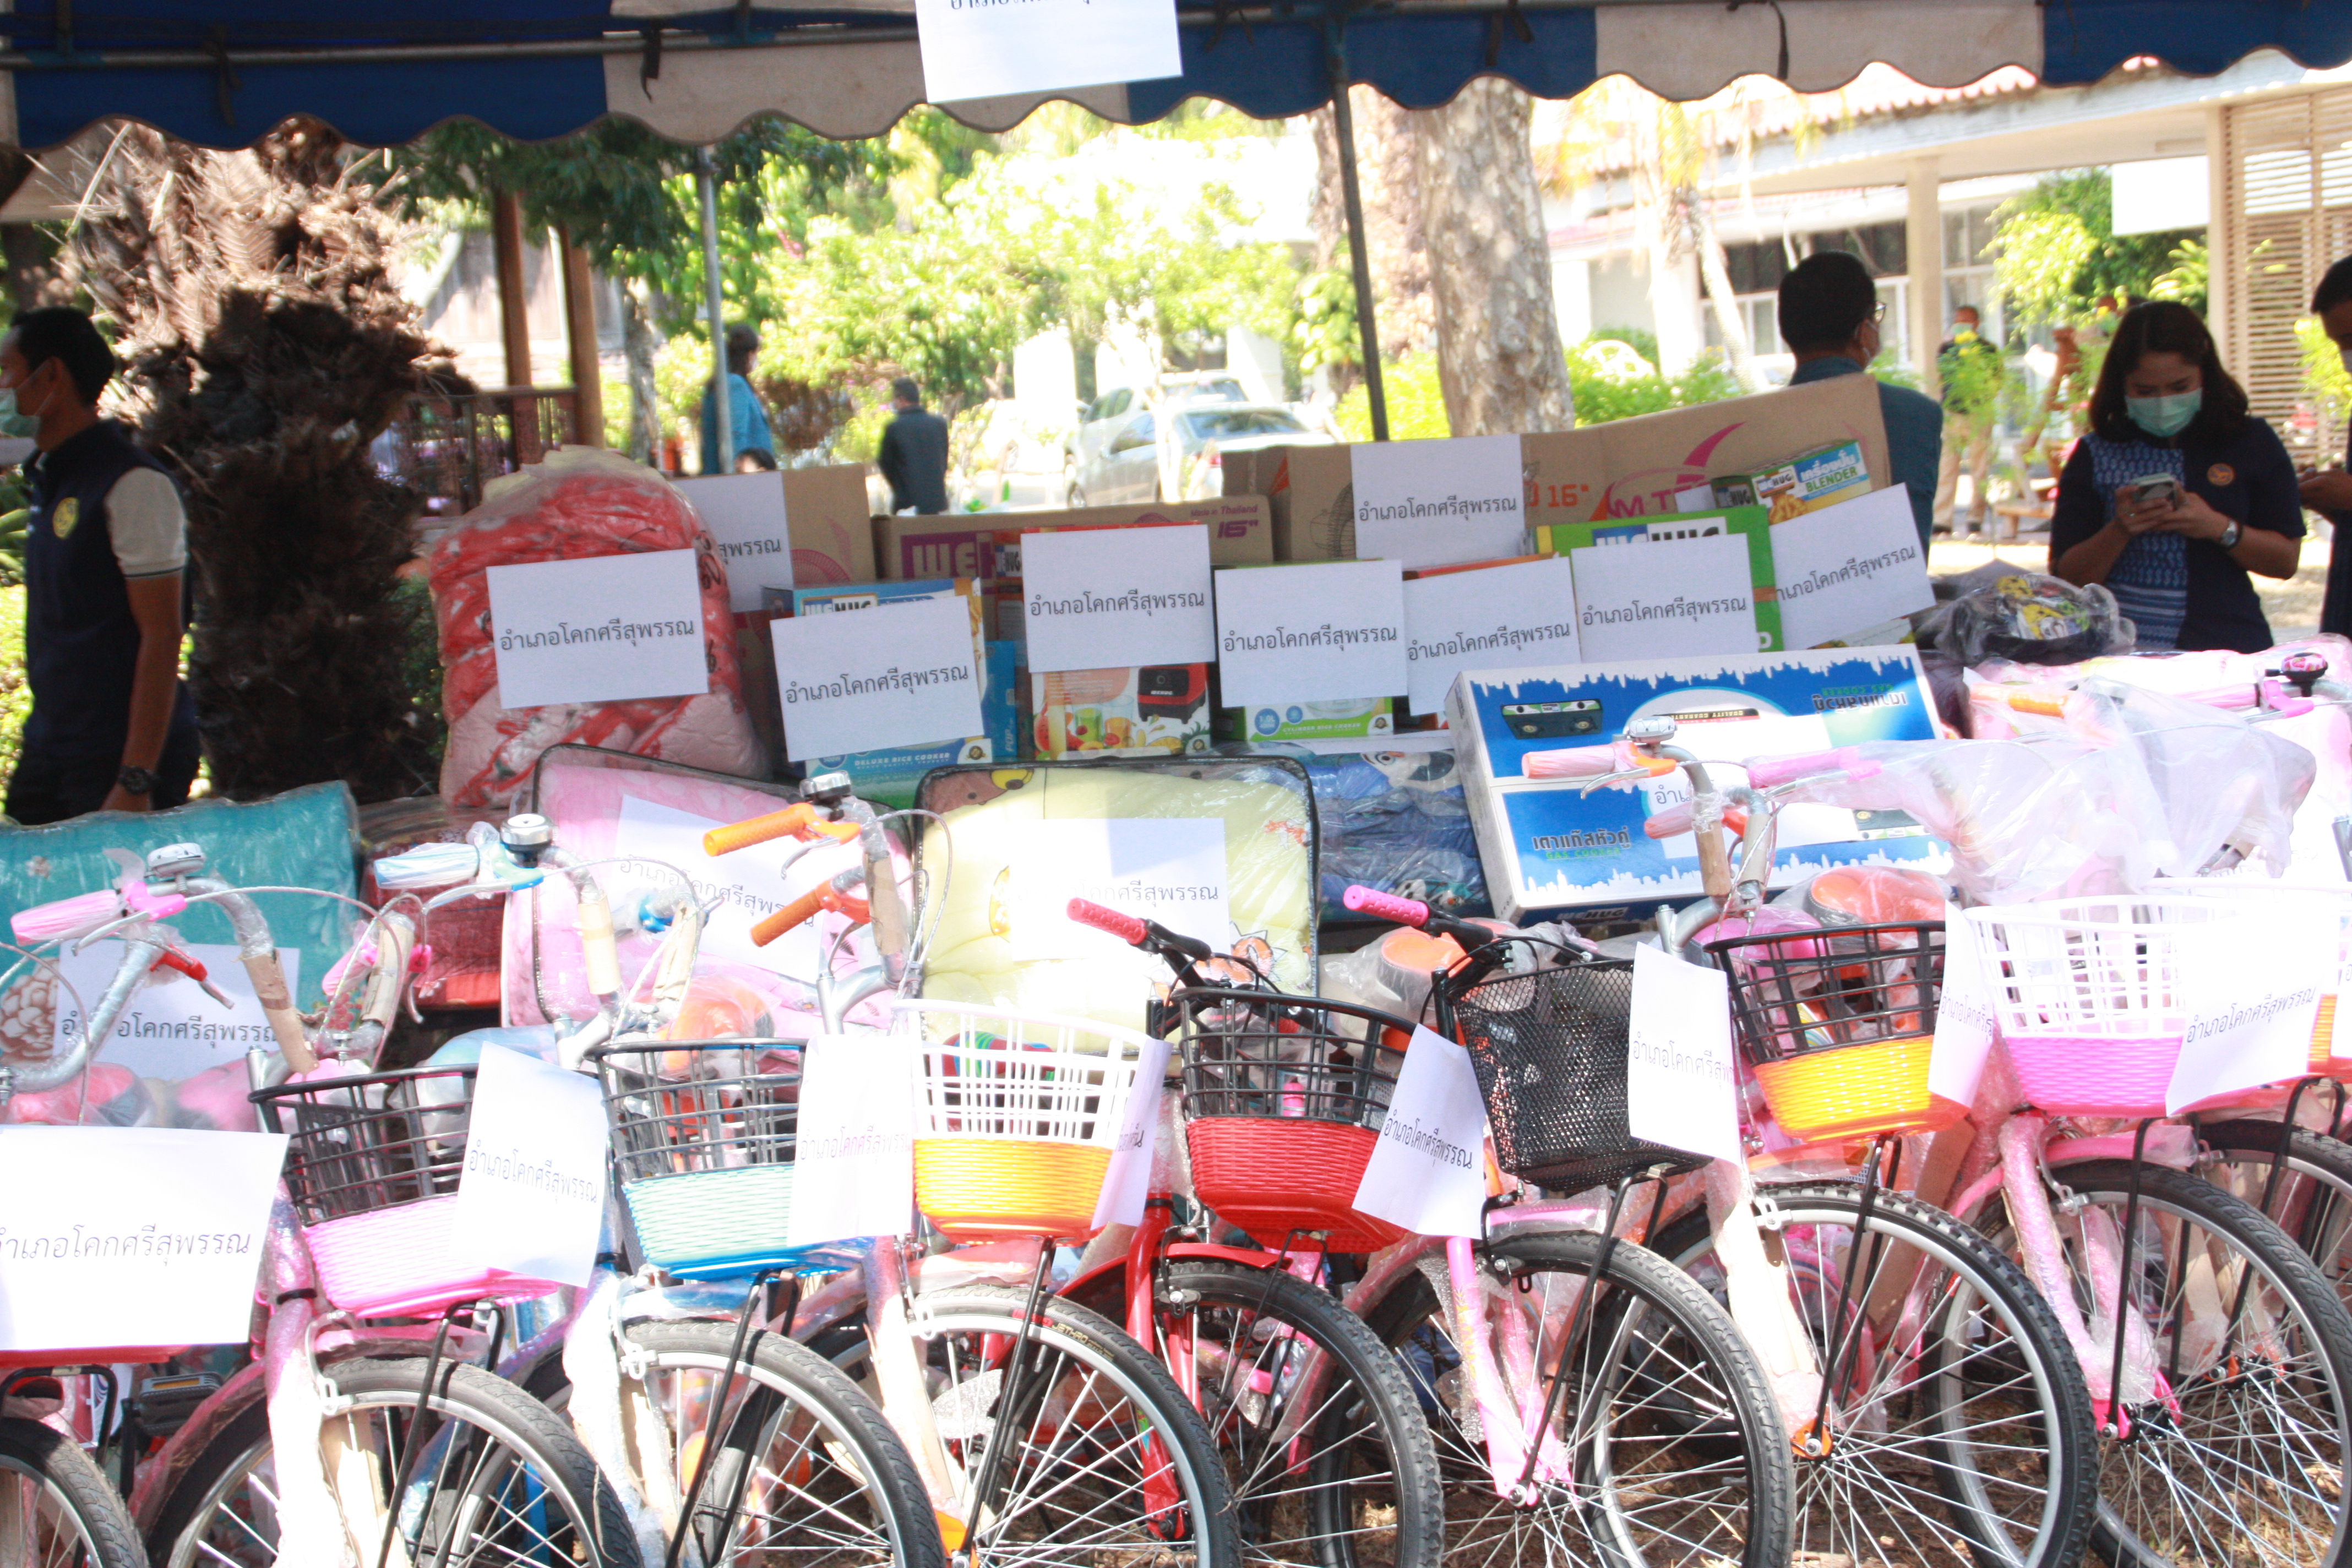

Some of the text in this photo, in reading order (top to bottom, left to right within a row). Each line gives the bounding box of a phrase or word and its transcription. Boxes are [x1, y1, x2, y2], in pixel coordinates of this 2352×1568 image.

[1805, 466, 1858, 492] BLENDER
[1221, 504, 1258, 514] Thailand
[1358, 496, 1517, 522] อำเภอโคกศรีสุพรรณ
[1778, 545, 1916, 601] ำเภอโคกศรีสุพรรณ
[1030, 590, 1205, 617] อำเภอโคกศรีสุพรรณ
[1583, 596, 1746, 625] อำเภอโคกศรีสุพรรณ
[500, 618, 694, 651] อำเภอโคกศรีสุพรรณ
[1224, 624, 1397, 651] อำเภอโคกศรีสุพรรณ
[1408, 621, 1570, 661] อำเภอโคกศรีสุพรรณ
[786, 666, 968, 703] อำเภอโคกศรีสุพรรณ
[1532, 826, 1630, 850] เตาแก๊สหัวคู่
[1546, 851, 1569, 859] GAS
[2186, 986, 2316, 1043] อำเภอโคกศรีสุพรรณ
[469, 1139, 598, 1204] อำเภอโคกศรีสุพรรณ
[0, 1222, 252, 1267] ำเภอโคกศรีสุพรรณ
